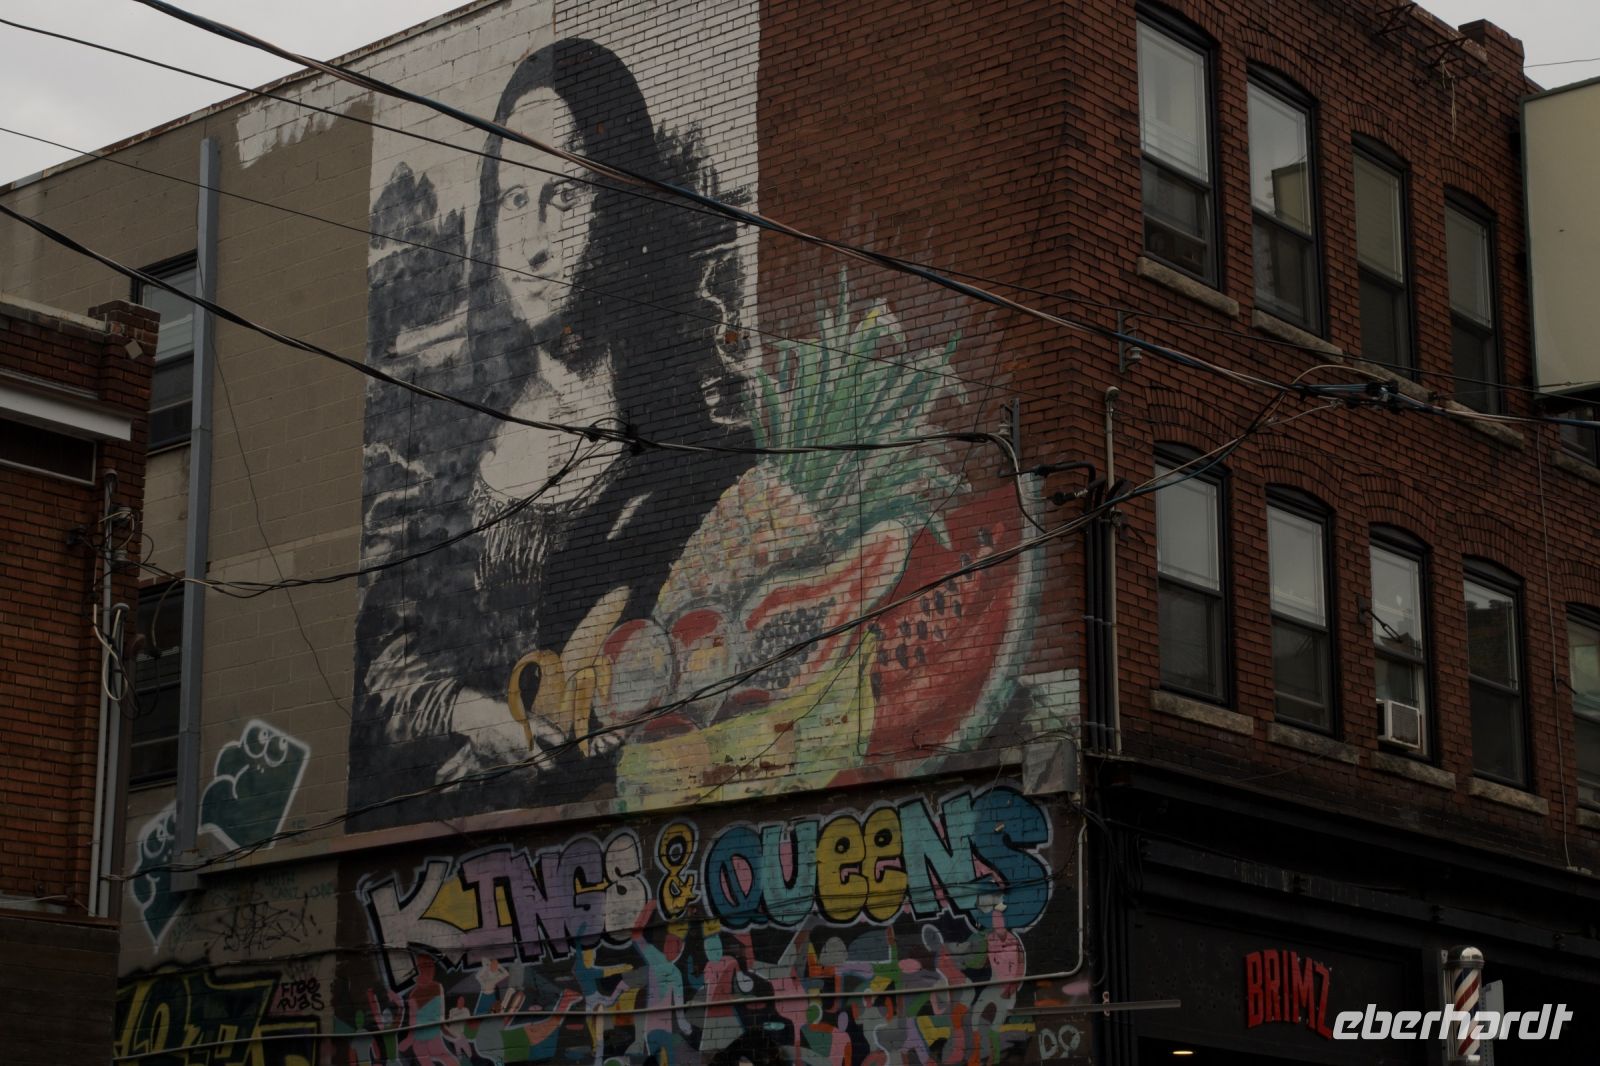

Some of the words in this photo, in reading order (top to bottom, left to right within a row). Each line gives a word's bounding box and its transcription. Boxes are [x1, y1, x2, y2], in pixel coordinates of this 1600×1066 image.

[362, 832, 649, 993] KINGS
[658, 821, 700, 922] &
[1244, 948, 1333, 1041] BRIMZ
